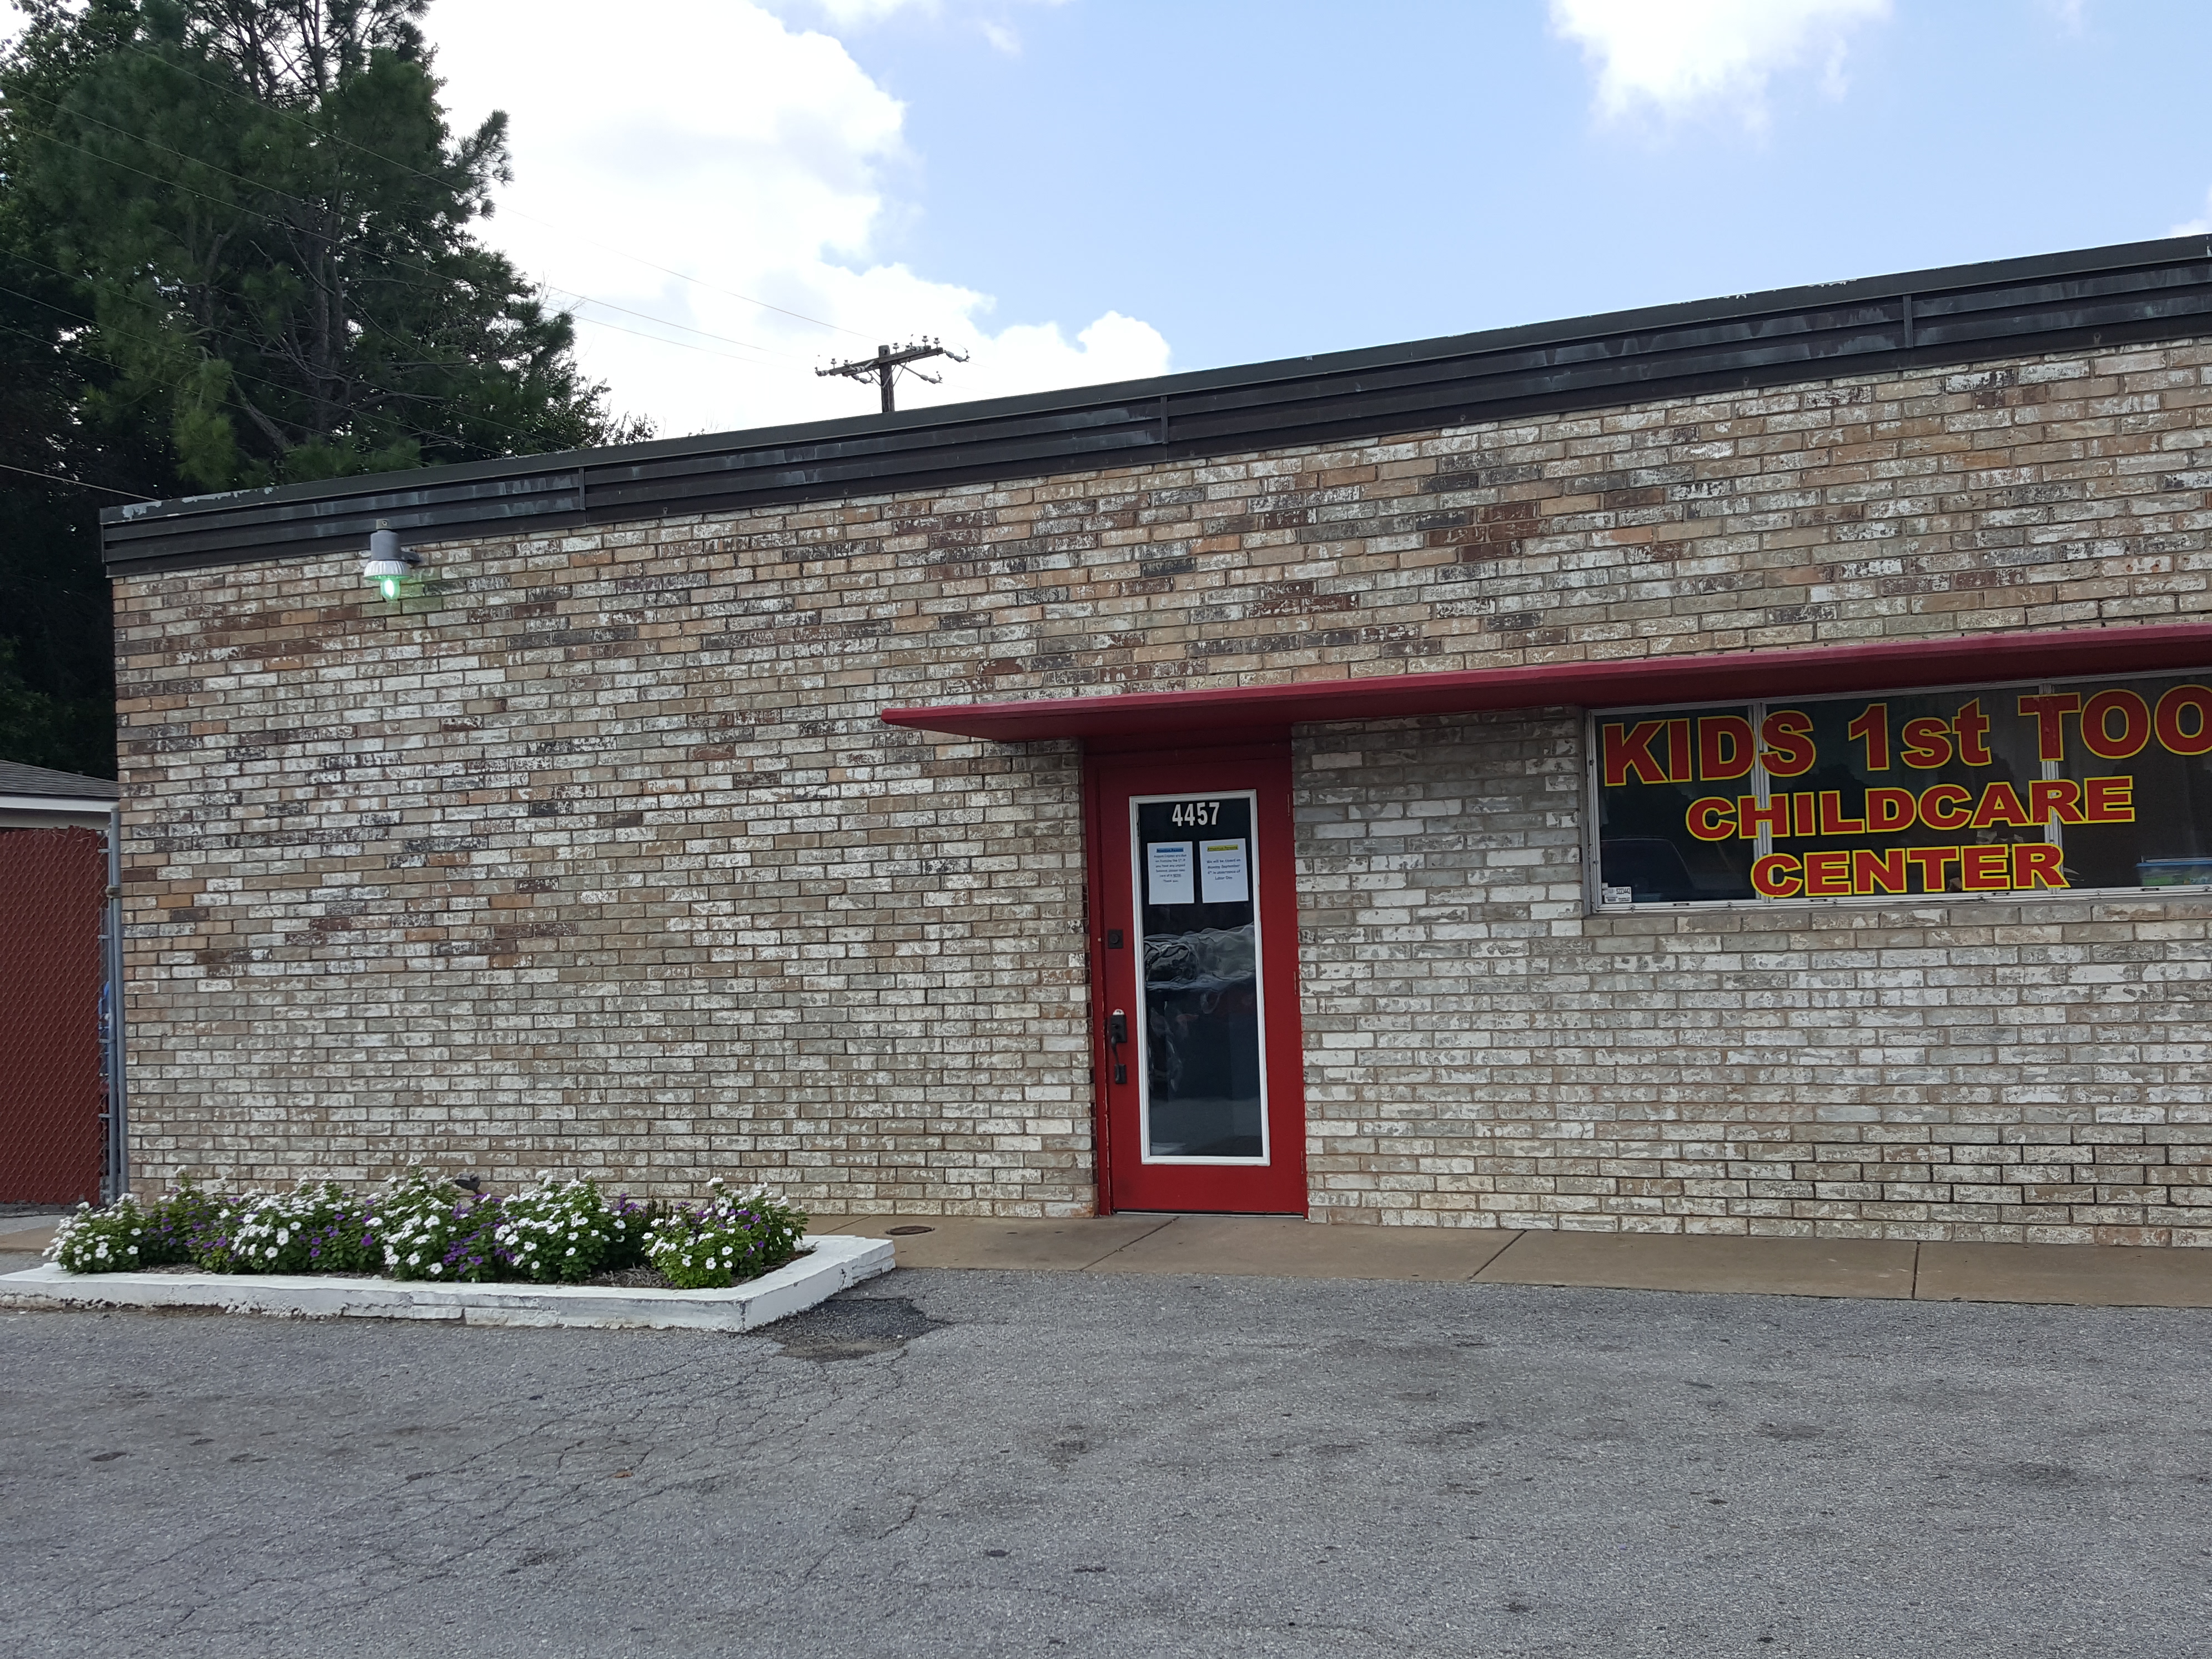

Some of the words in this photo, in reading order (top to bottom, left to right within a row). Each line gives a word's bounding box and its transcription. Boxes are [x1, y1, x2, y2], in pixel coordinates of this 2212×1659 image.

[1603, 710, 1816, 787] KIDS
[1848, 697, 1992, 771] 1st
[2018, 684, 2212, 761] TOO
[1172, 802, 1220, 827] 4457
[1686, 775, 2135, 841] CHILDCARE
[1751, 843, 2071, 898] CENTER
